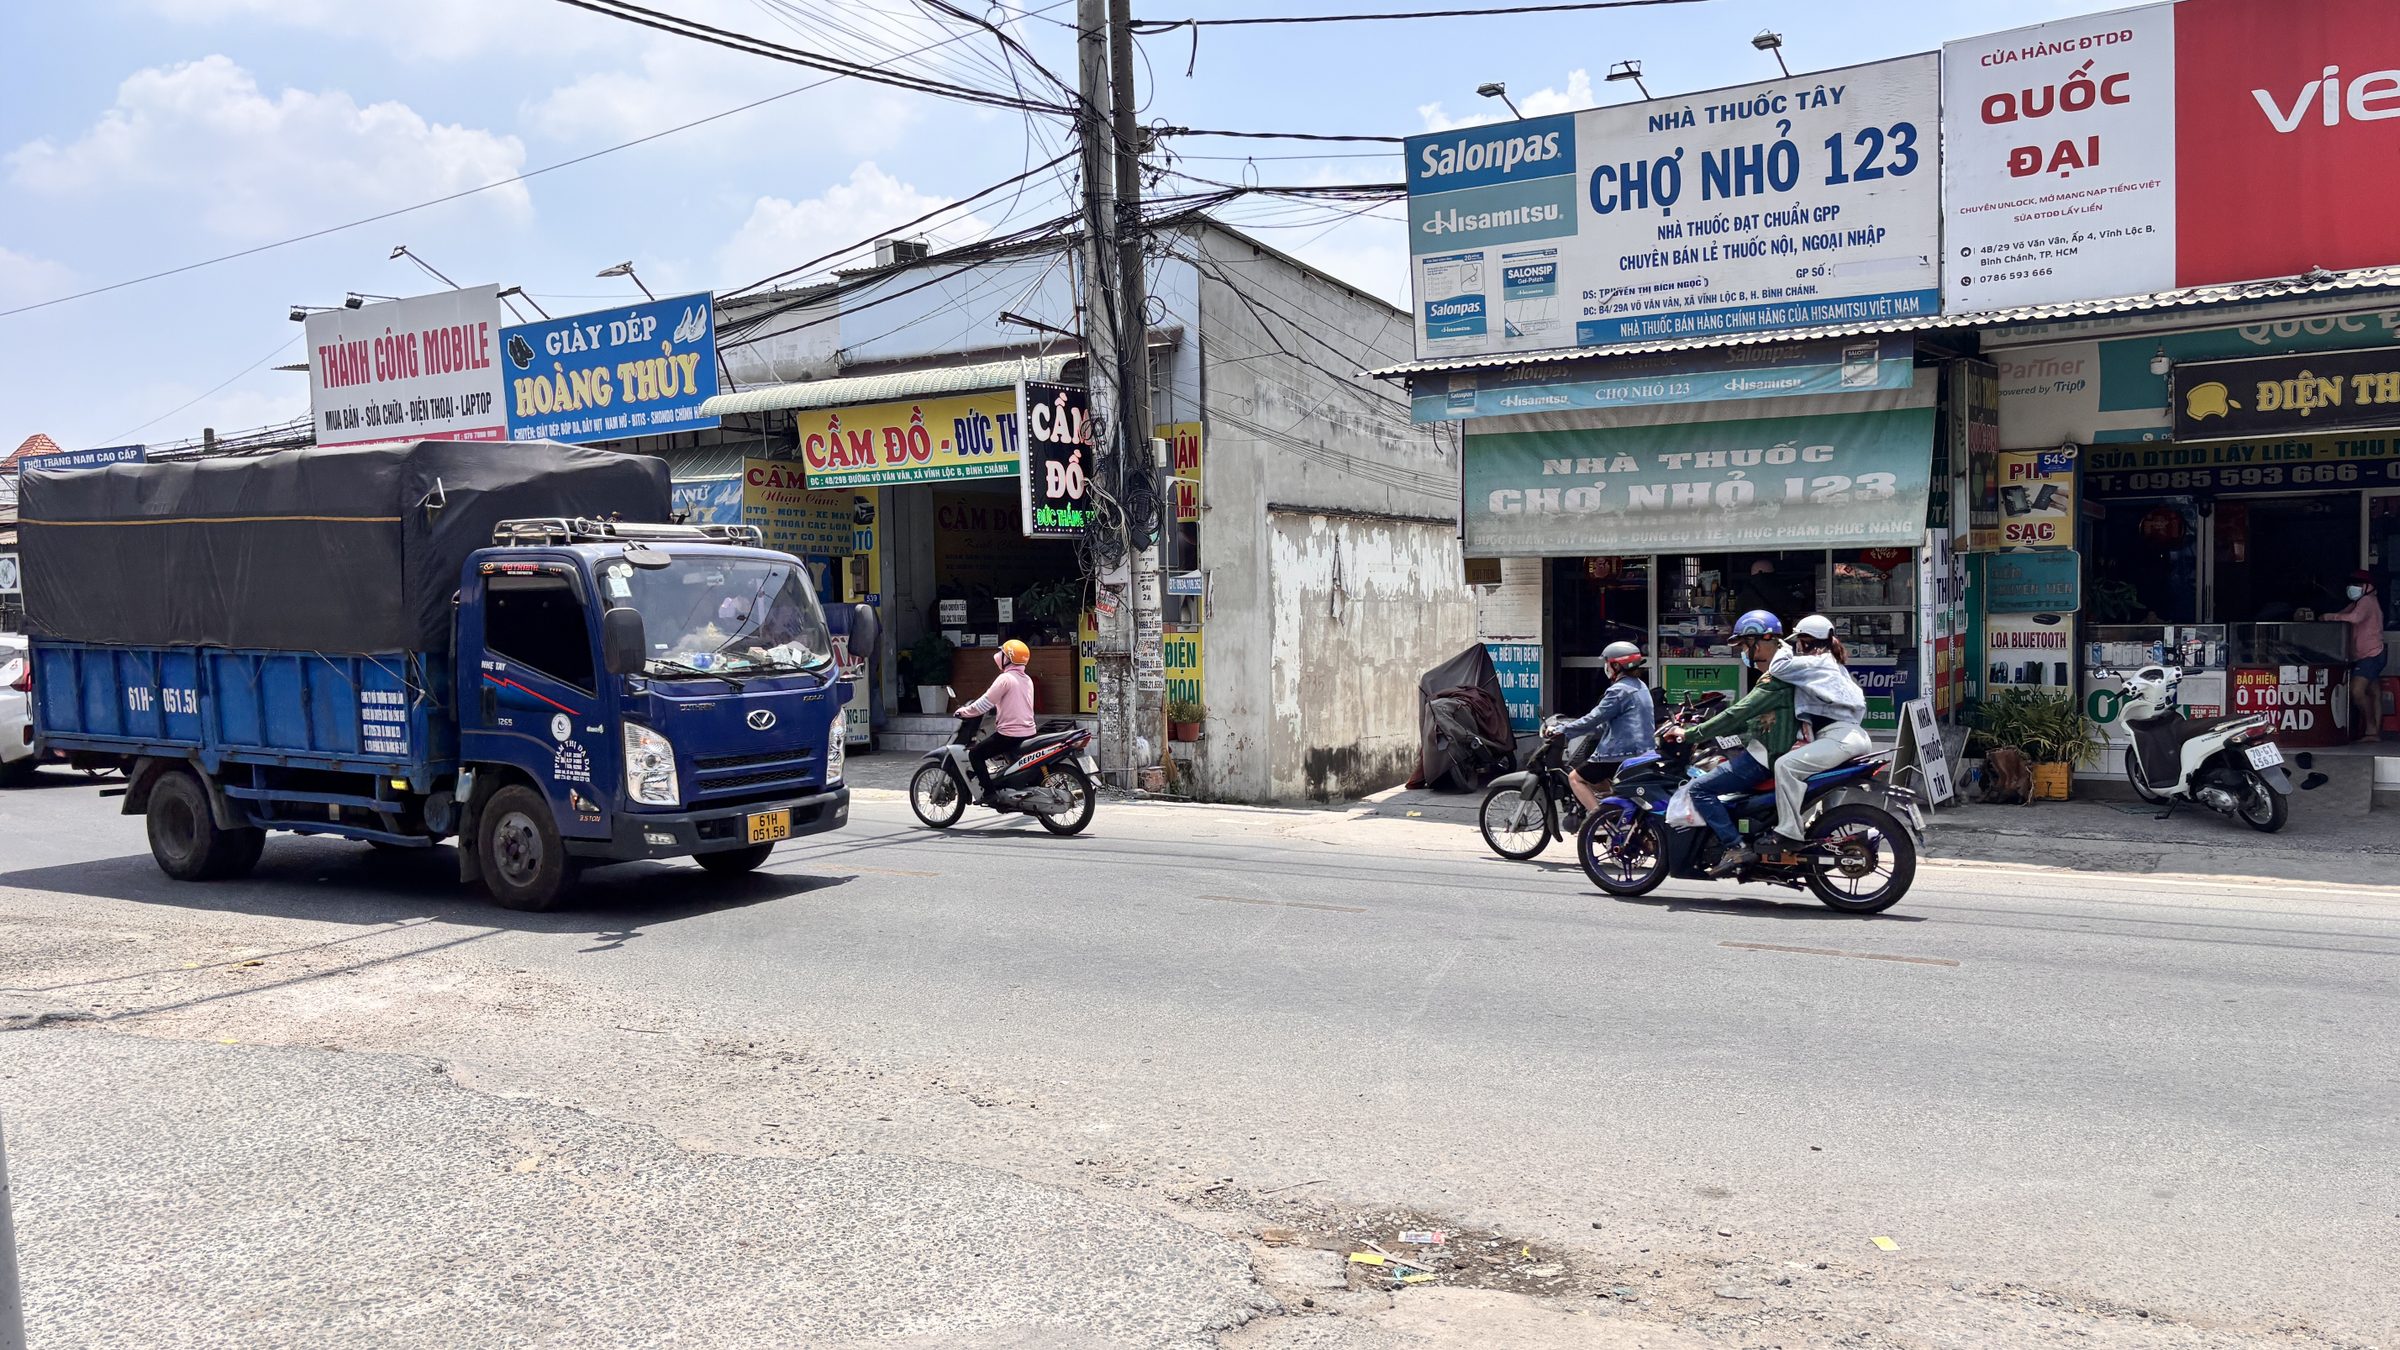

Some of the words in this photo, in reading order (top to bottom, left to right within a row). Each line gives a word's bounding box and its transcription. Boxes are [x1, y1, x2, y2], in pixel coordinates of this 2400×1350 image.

[1981, 49, 2018, 67] CỬA
[2021, 39, 2075, 61] HÀNG
[2078, 29, 2133, 50] ĐTDĐ
[1981, 58, 2130, 125] QUỐC
[1649, 109, 1696, 133] NHÀ
[1704, 90, 1788, 125] THUỐC
[1795, 84, 1847, 109] TÂY
[1420, 131, 1560, 179] Salonpas
[1589, 145, 1684, 218] CHỢ
[1701, 118, 1800, 202] NHỎ
[1824, 121, 1919, 187] 123
[2007, 135, 2100, 179] ĐẠI
[1960, 202, 1997, 215] CHUYÊN
[1997, 196, 2038, 210] UNLOCK,
[2056, 190, 2085, 202] MẠNG
[2086, 186, 2107, 200] NẠP
[2109, 183, 2138, 195] TIẾNG
[2139, 178, 2161, 190] VIỆT
[1422, 203, 1559, 235] Hisamitsu
[1657, 218, 1683, 241] NHÀ
[1686, 210, 1730, 238] THUỐC
[1733, 212, 1759, 234] ĐẠT
[1763, 201, 1810, 230] CHUẨN
[1812, 204, 1841, 224] GPP
[2061, 206, 2080, 217] LẤY
[1619, 245, 1669, 272] CHUYÊN
[1672, 242, 1699, 266] BÁN
[1702, 239, 1719, 263] LẺ
[1722, 233, 1767, 259] THUỐC
[1770, 233, 1798, 257] NỘI,
[1801, 229, 1843, 253] NGOẠI
[1846, 226, 1886, 248] NHẬP
[2012, 240, 2025, 250] Võ
[2027, 236, 2045, 248] Văn
[2047, 235, 2069, 246] Vân,
[2071, 230, 2084, 243] Ấp
[2087, 232, 2096, 241] 4,
[2100, 227, 2122, 239] Vĩnh
[2125, 224, 2142, 236] Lộc
[2145, 223, 2156, 234] B,
[1980, 255, 2001, 266] Bình
[2004, 252, 2037, 264] Chánh,
[2039, 249, 2053, 259] TP.
[2055, 246, 2078, 257] HCM
[1507, 265, 1553, 279] SALONSIP
[1796, 267, 1810, 279] GP
[1811, 262, 1825, 277] SỐ
[1980, 272, 2006, 284] 0786
[2009, 269, 2029, 280] 593
[2032, 267, 2053, 278] 666
[1598, 302, 1629, 315] B4/29A
[1719, 290, 1737, 302] LỘC
[1738, 291, 1748, 301] B,
[1750, 290, 1760, 300] H.
[1762, 286, 1783, 299] BÌNH
[1785, 283, 1819, 297] CHÁNH.
[1638, 285, 1651, 295] THỊ
[1653, 280, 1675, 292] BÍCH
[1677, 276, 1702, 290] NGỌC
[1430, 302, 1481, 317] Salonpas
[1620, 319, 1641, 338] NHÀ
[1641, 313, 1673, 336] THUỐC
[1674, 312, 1695, 332] BÁN
[1696, 310, 1725, 330] HÀNG
[1725, 307, 1756, 328] CHÍNH
[1758, 304, 1787, 325] HÃNG
[1787, 302, 1810, 322] CỦA
[1811, 300, 1868, 321] HISAMITSU
[1868, 297, 1893, 316] VIỆT
[1894, 296, 1920, 314] NAM
[545, 321, 603, 356] GIÀY
[609, 311, 657, 347] DÉP
[318, 334, 372, 389] THÀNH
[374, 326, 419, 383] CÔNG
[422, 321, 490, 376] MOBILE
[513, 361, 613, 418] HOÀNG
[617, 339, 700, 404] THỦY
[2000, 359, 2085, 380] Partner
[1595, 385, 1630, 401] CHỢ
[1631, 380, 1664, 398] NHỎ
[1668, 383, 1690, 396] 123
[2038, 384, 2051, 396] by
[2256, 370, 2344, 416] ĐIỆN
[325, 410, 343, 431] MUA
[343, 404, 360, 430] BÁN
[366, 398, 382, 427] SỬA
[382, 399, 404, 426] CHỮA
[409, 395, 429, 427] ĐIỆN
[430, 396, 454, 424] THOẠI
[460, 391, 492, 417] LAPTOP
[604, 416, 620, 430] NAM
[1031, 391, 1093, 446] CẦM
[805, 412, 878, 470] CẦM
[882, 405, 933, 465] ĐỒ
[953, 408, 994, 458] ĐỨC
[2213, 441, 2257, 463] LẤY
[2262, 438, 2313, 461] LIỀN
[44, 456, 71, 468] TRANG
[73, 453, 95, 465] NAM
[96, 452, 115, 462] CAO
[118, 448, 138, 460] CẤP
[965, 464, 983, 476] BÌNH
[984, 461, 1009, 475] CHÁNH
[1542, 449, 1640, 476] NHÀ
[1658, 439, 1835, 471] THUỐC
[2043, 454, 2067, 466] 543
[1045, 449, 1087, 500] ĐỒ
[2129, 470, 2212, 491] 0985
[2219, 466, 2284, 487] 593
[2292, 463, 2359, 484] 666
[1488, 480, 1607, 516] CHỢ
[1627, 470, 1756, 512] NHỎ
[1783, 471, 1898, 506] 123
[1036, 504, 1057, 527] ĐỨC
[2006, 522, 2056, 545] SẠC
[1991, 631, 2009, 649] LOA
[2012, 631, 2067, 649] BLUETOOTH
[1164, 635, 1197, 674] ĐIỆN
[1684, 668, 1721, 679] TIFFY
[2236, 671, 2254, 686] BẢO
[2255, 671, 2277, 685] HIỂM
[2236, 685, 2249, 706] Ô
[2254, 685, 2279, 706] TÔ
[1917, 702, 1933, 730] NHÀ
[1018, 749, 1047, 767] REPSOL
[1921, 733, 1944, 765] THUỐC
[1933, 771, 1949, 797] TÂY
[752, 825, 786, 842] 051.58
[759, 813, 779, 827] 61H
